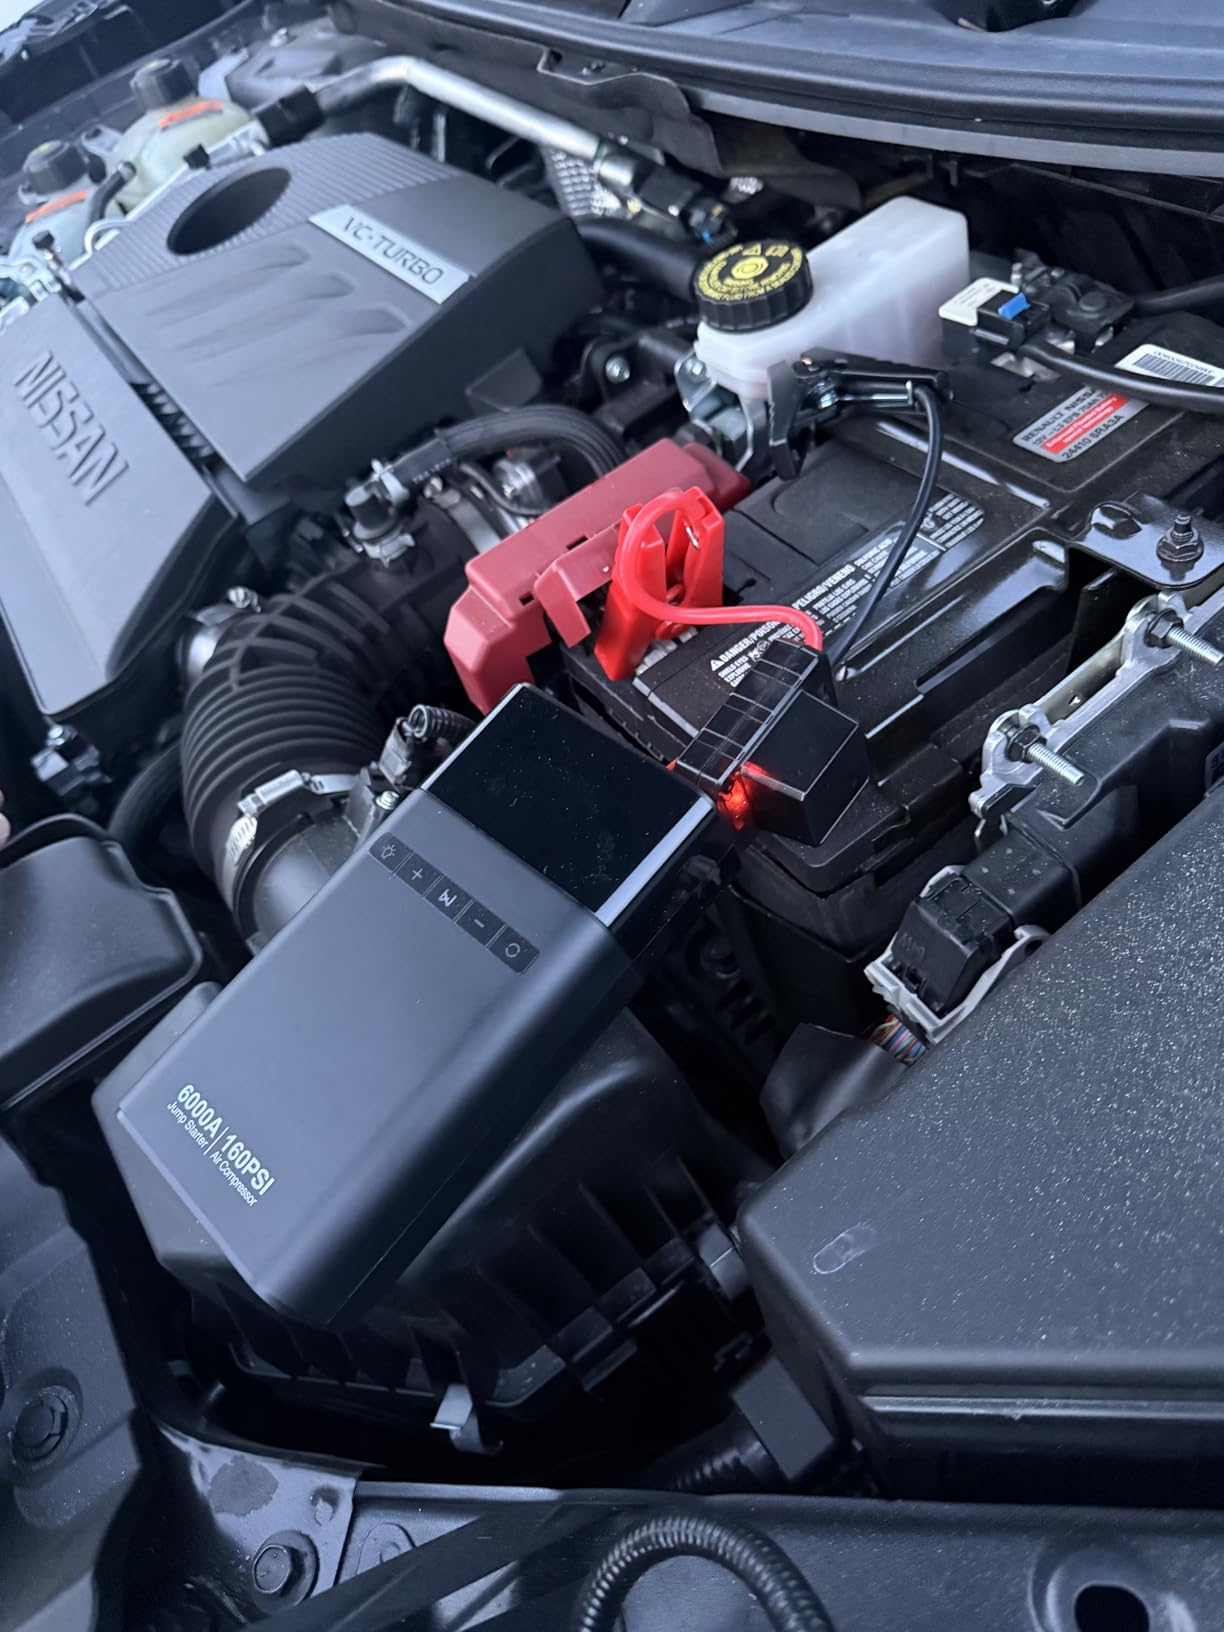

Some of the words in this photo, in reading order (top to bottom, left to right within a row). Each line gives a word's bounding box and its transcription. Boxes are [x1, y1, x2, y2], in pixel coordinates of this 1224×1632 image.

[343, 216, 445, 285] VC-TURBO
[13, 350, 130, 507] NISSAN
[1020, 412, 1064, 443] RENAULT
[1062, 437, 1093, 460] 24410
[167, 1101, 188, 1124] Jump
[184, 1119, 209, 1149] Starter
[177, 1084, 223, 1139] 6000A
[209, 1151, 223, 1165] Air
[219, 1160, 258, 1207] Compressor
[221, 1134, 276, 1197] 160PSI
